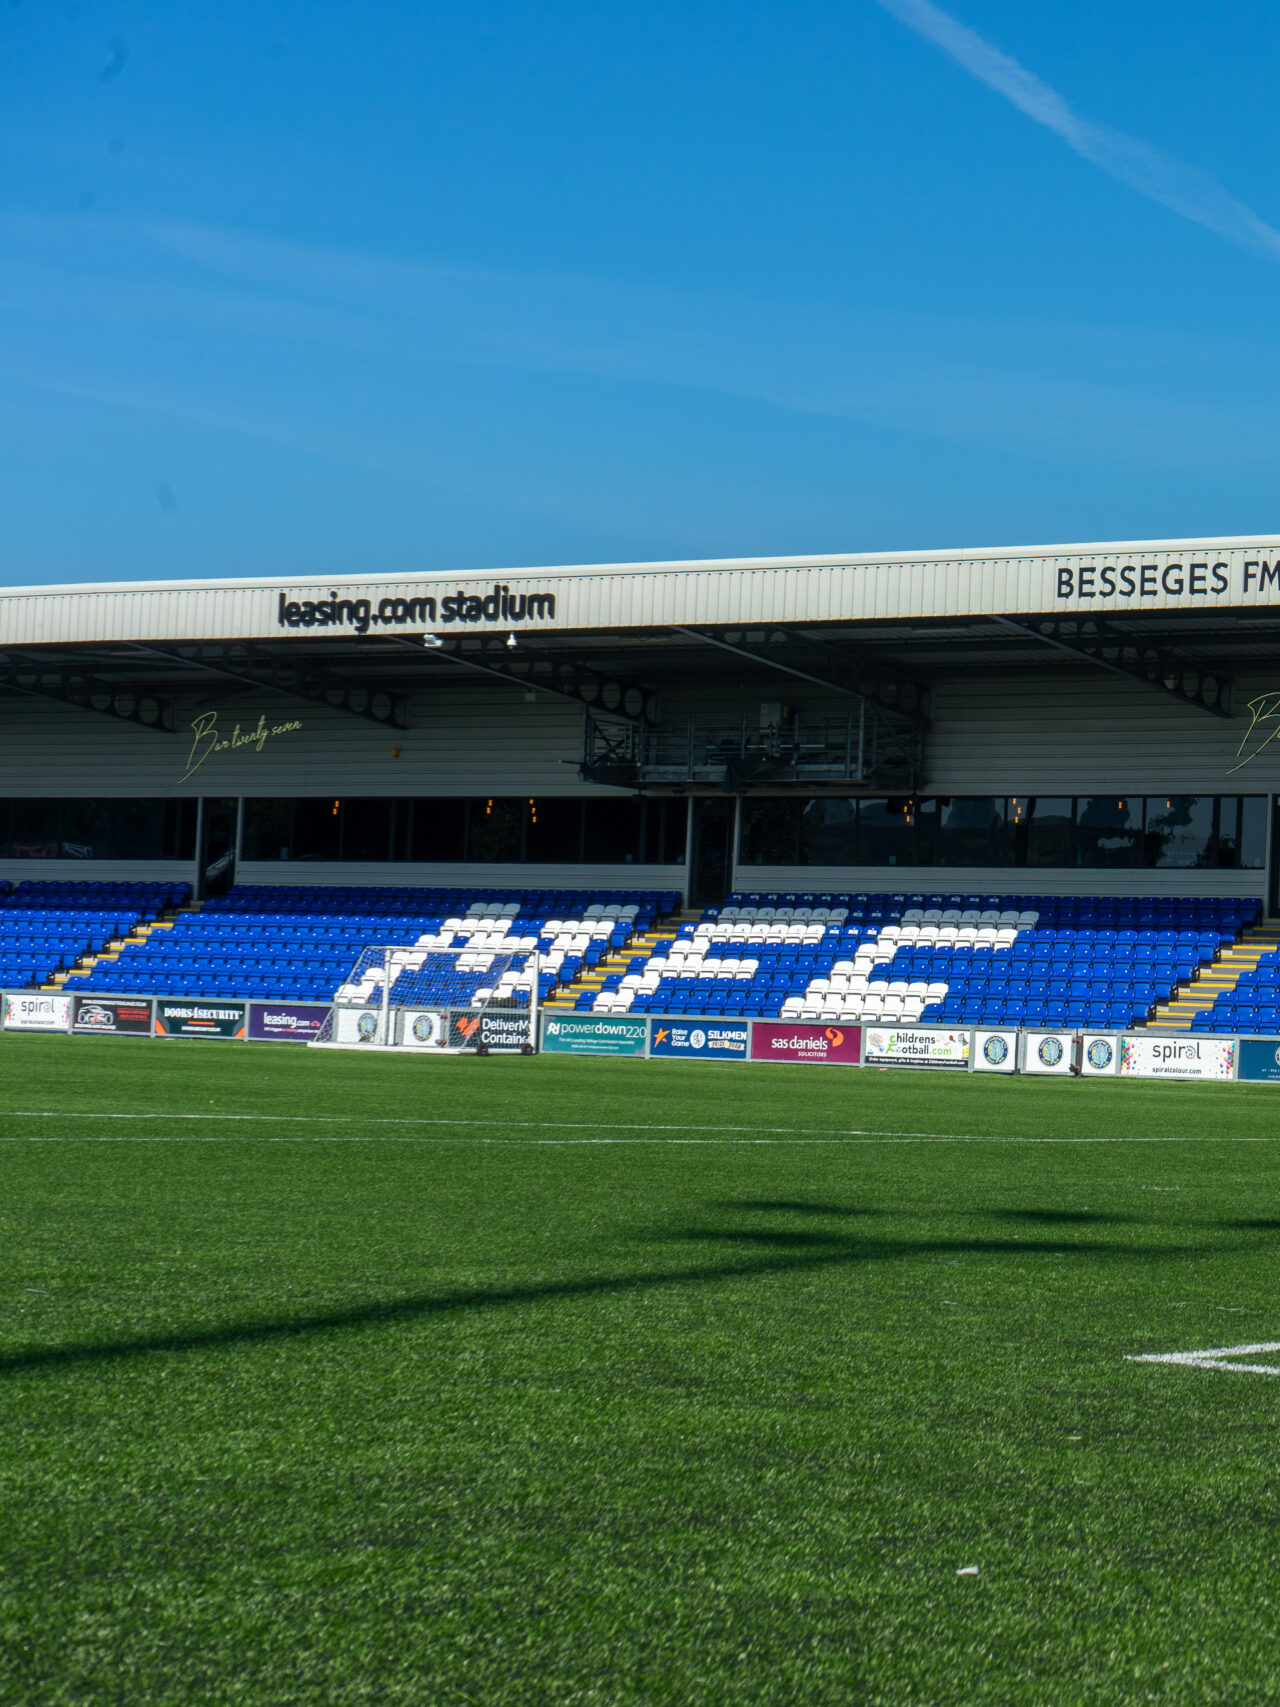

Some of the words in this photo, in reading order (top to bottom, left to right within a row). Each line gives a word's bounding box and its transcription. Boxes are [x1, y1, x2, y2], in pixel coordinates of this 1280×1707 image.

[1057, 562, 1229, 599] BESSEGES
[278, 591, 437, 634] leasing.com
[440, 584, 556, 623] stadium
[177, 711, 230, 784] Bar
[231, 715, 269, 752] twenty
[271, 720, 303, 736] seven
[263, 1011, 310, 1029] leasing.com
[707, 1030, 747, 1040] SILKMEN
[771, 1038, 788, 1049] sas
[789, 1035, 828, 1050] daniels
[1152, 1066, 1202, 1075] spiralcolour.com
